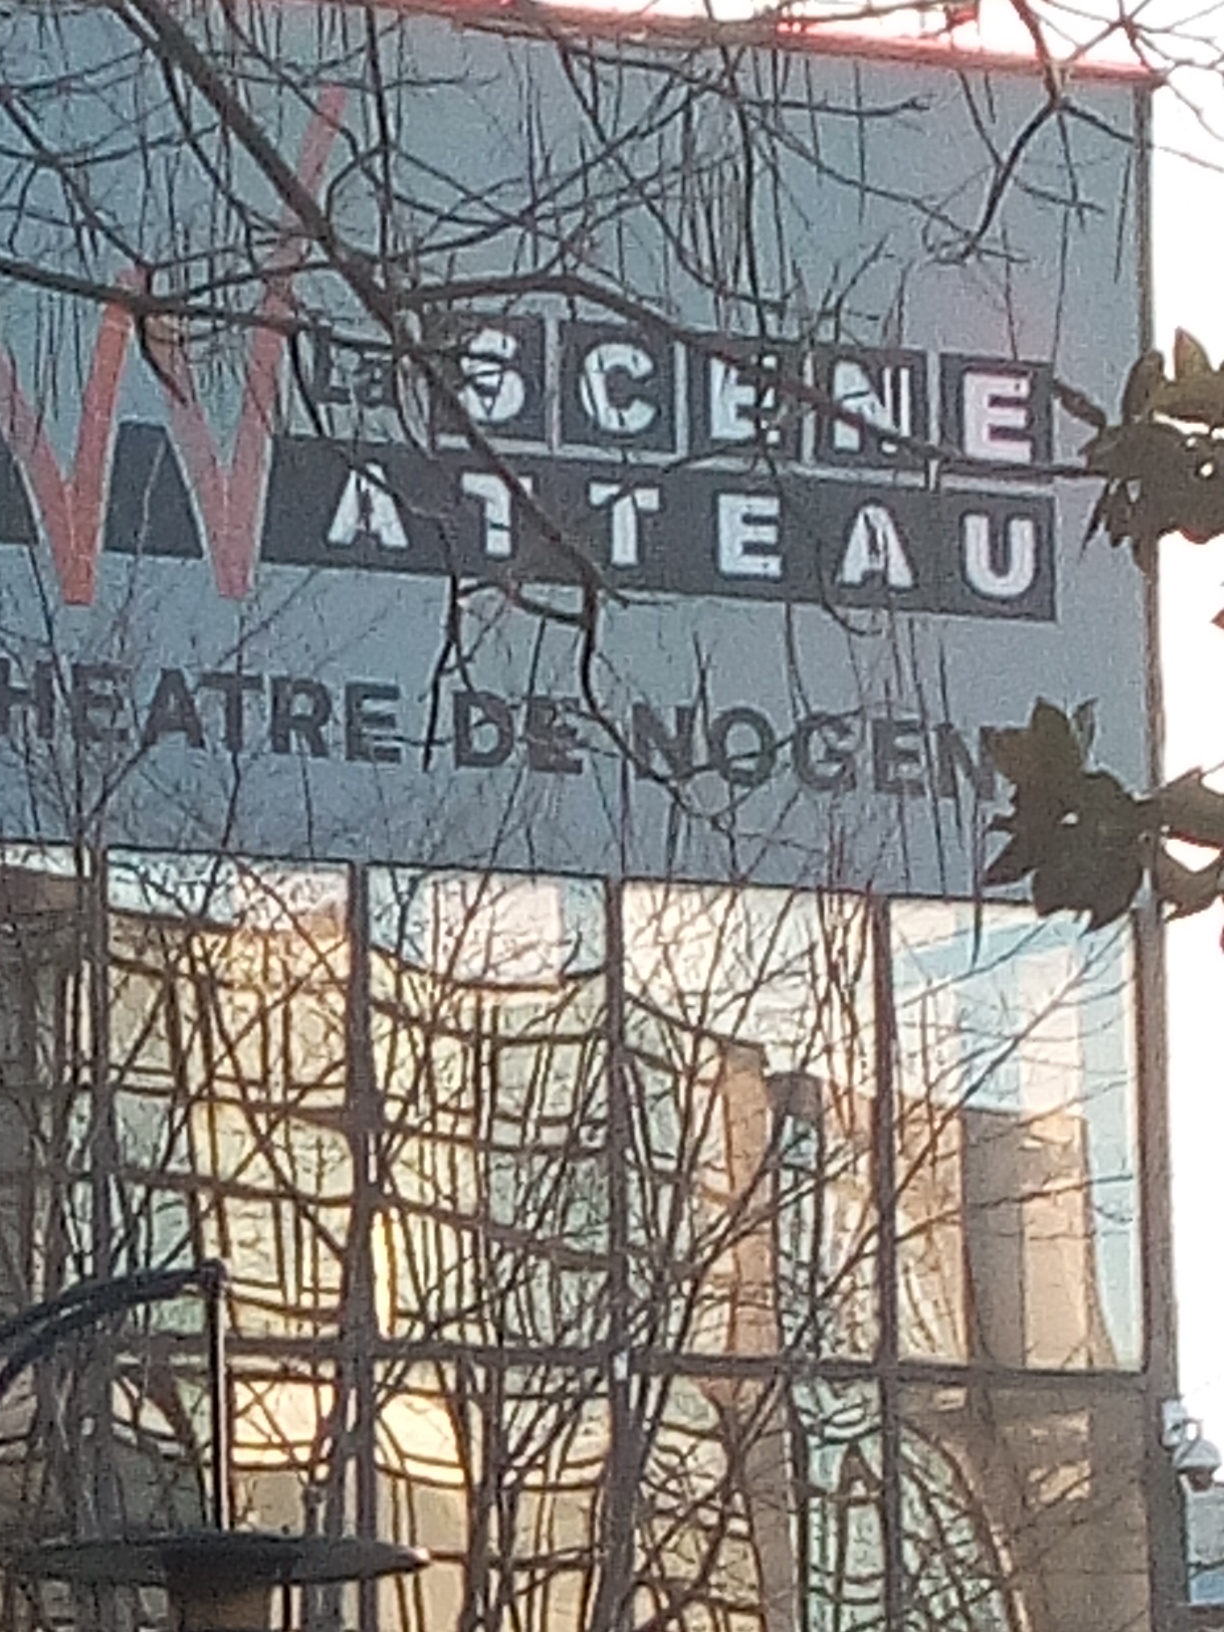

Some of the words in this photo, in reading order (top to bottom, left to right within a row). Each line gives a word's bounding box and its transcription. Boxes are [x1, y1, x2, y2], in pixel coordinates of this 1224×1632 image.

[460, 326, 1034, 464] SCENE
[453, 691, 584, 775] DE
[634, 704, 996, 800] NOGEN
